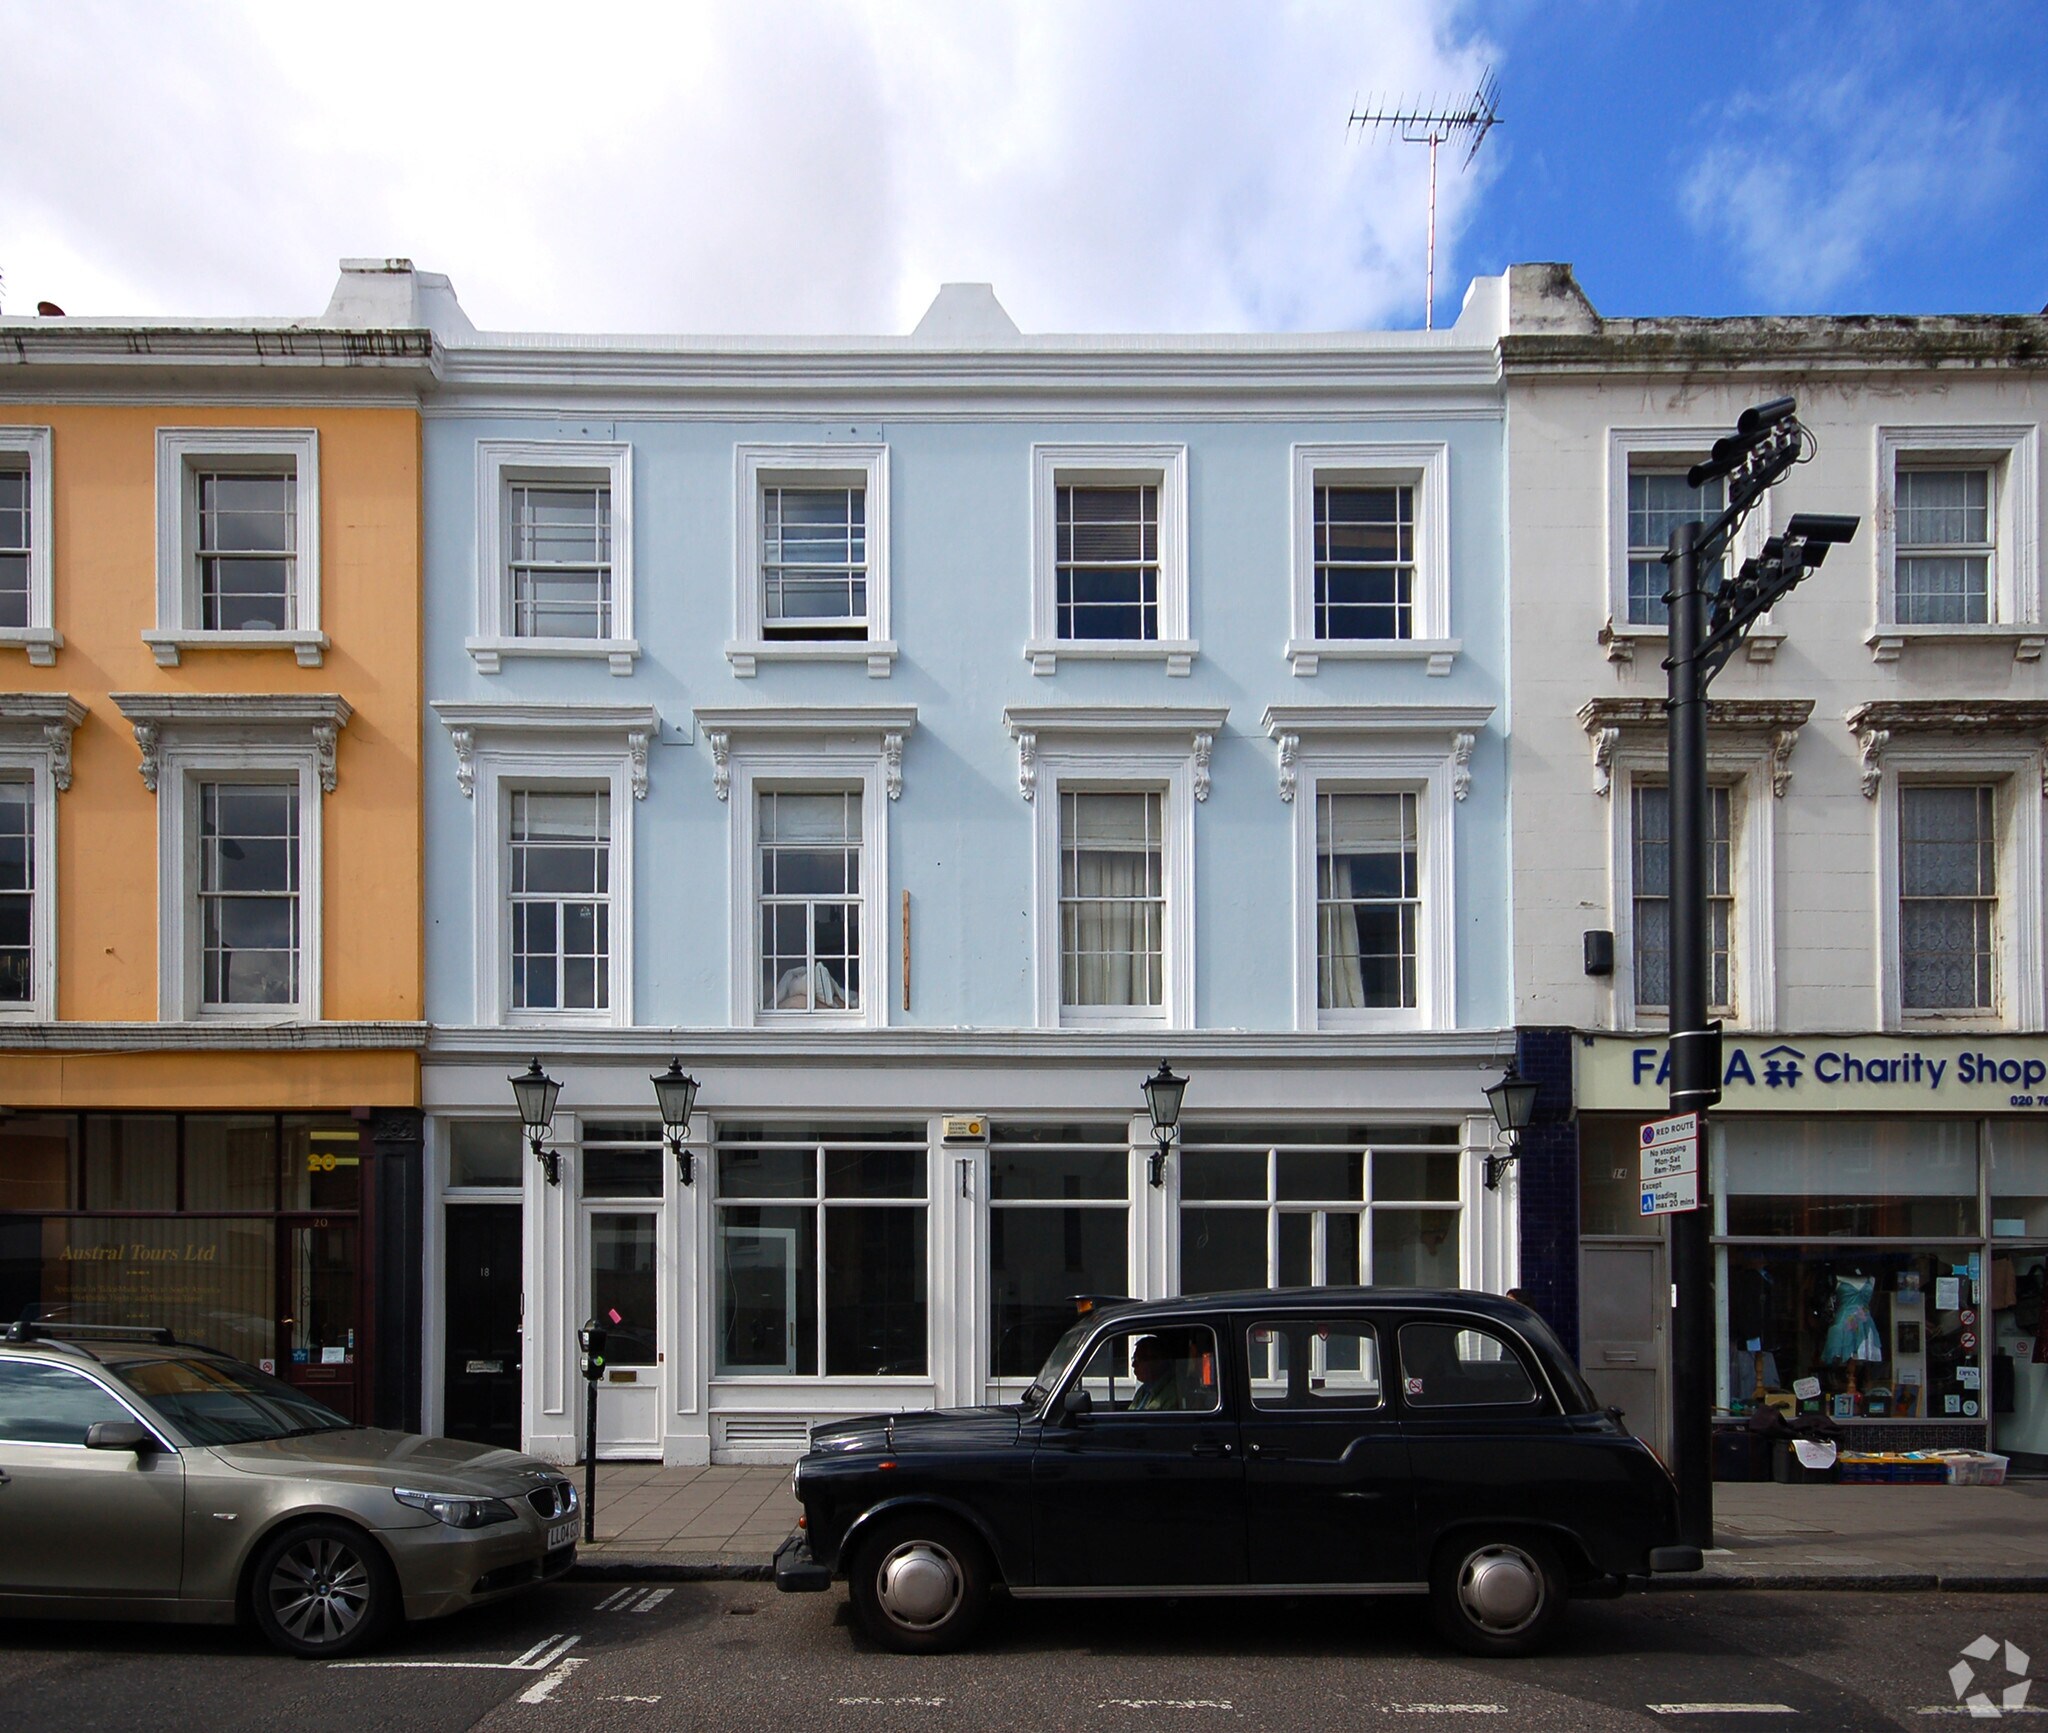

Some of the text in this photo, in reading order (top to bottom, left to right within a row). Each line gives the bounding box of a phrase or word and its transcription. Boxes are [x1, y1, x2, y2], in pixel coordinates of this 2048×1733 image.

[1632, 1048, 2048, 1090] FAA Charity Shop
[2010, 1095, 2034, 1106] 020
[1656, 1121, 1694, 1135] RED ROUTE
[1650, 1145, 1686, 1158] No stopping
[306, 1153, 337, 1172] 20
[1655, 1156, 1681, 1165] Mon-Sat
[1654, 1164, 1681, 1174] 8am-7pm
[1642, 1181, 1662, 1191] Except
[1655, 1192, 1677, 1200] loading
[1655, 1198, 1695, 1209] max 20 mins
[314, 1218, 328, 1228] 20
[59, 1243, 217, 1262] Austral Tours Ltd
[480, 1267, 490, 1277] 18
